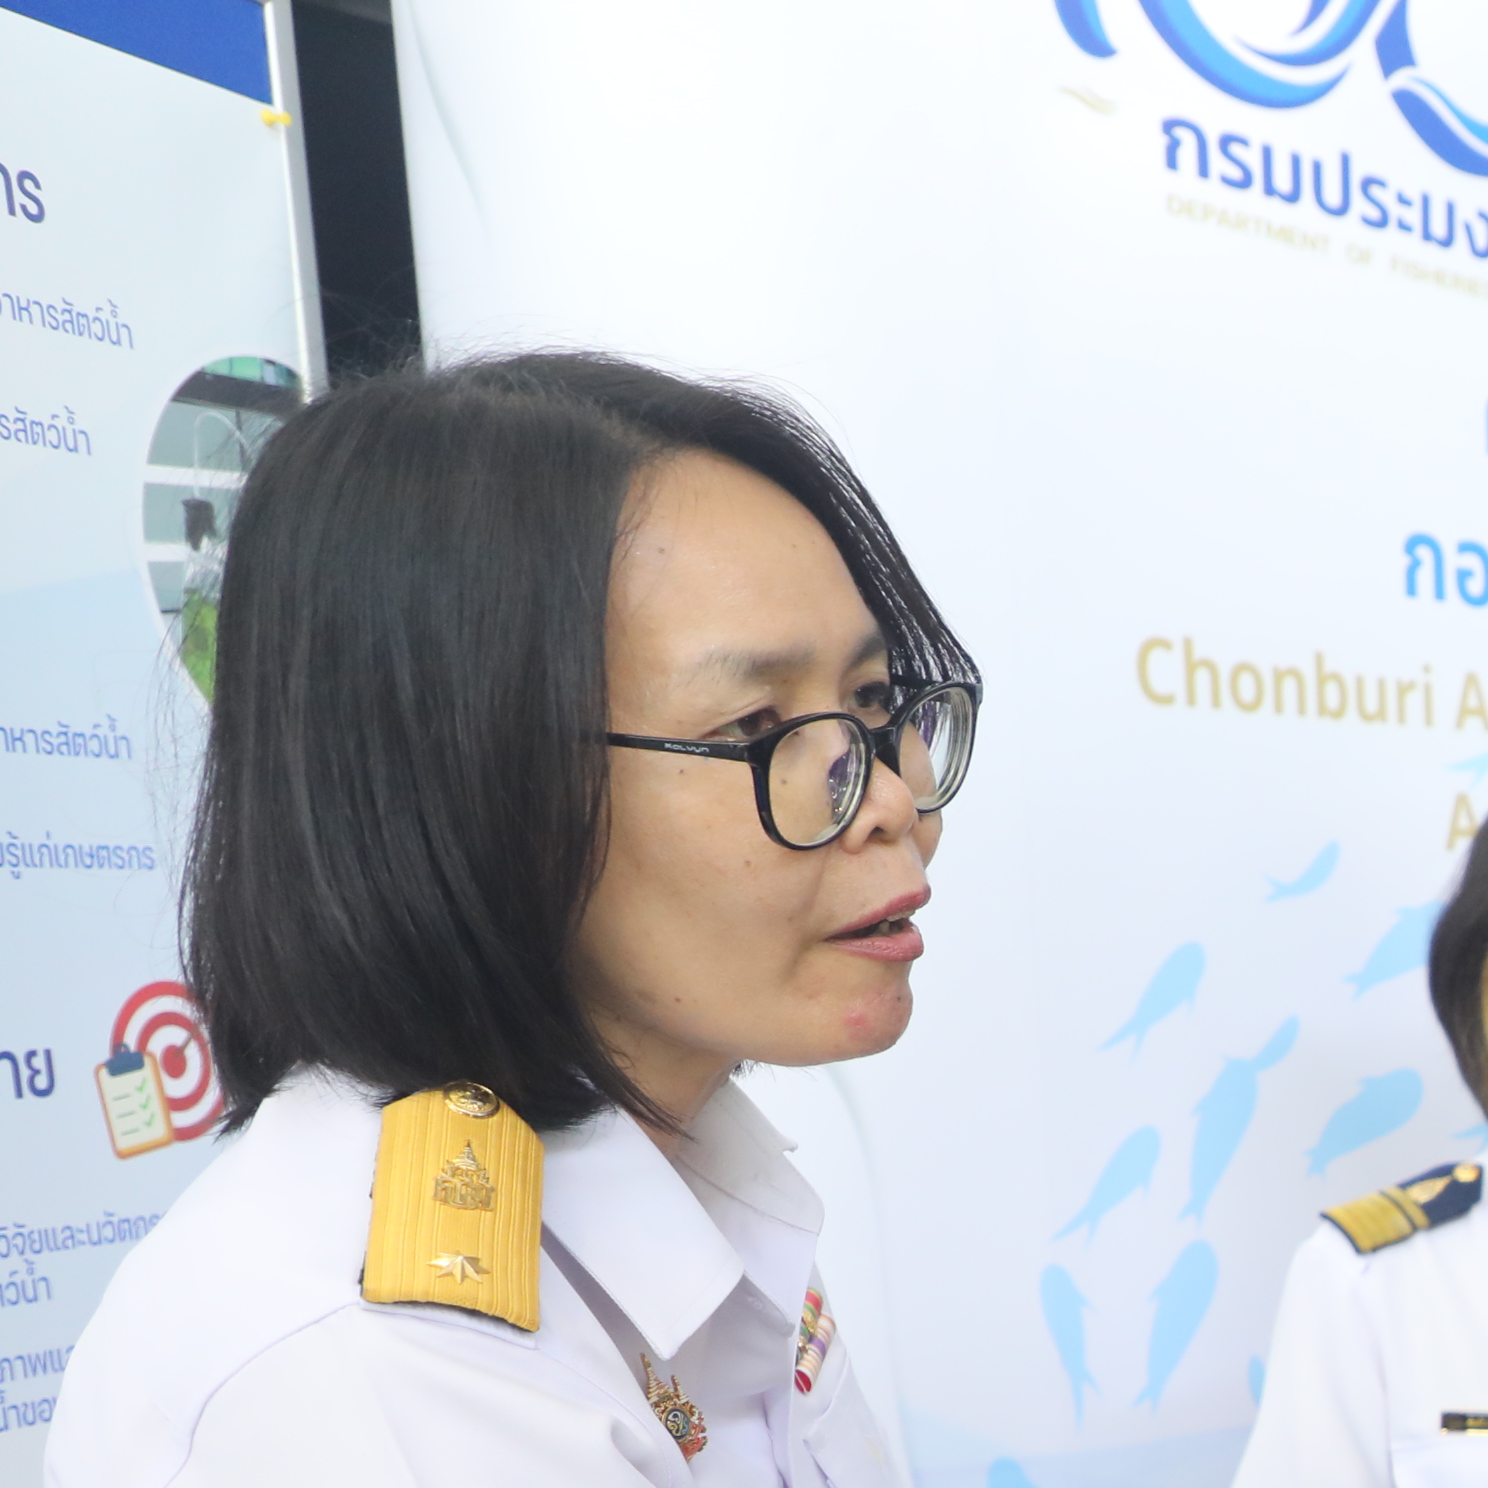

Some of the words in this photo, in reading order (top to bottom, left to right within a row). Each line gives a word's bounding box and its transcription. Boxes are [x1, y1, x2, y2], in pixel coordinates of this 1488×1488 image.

[1167, 193, 1330, 254] DEPARTMENT
[1346, 243, 1374, 266] OF
[0, 293, 134, 350] าหารสัตว์น้ำ
[1135, 636, 1434, 727] Chonburi
[0, 1258, 51, 1308] ว์น้ำ
